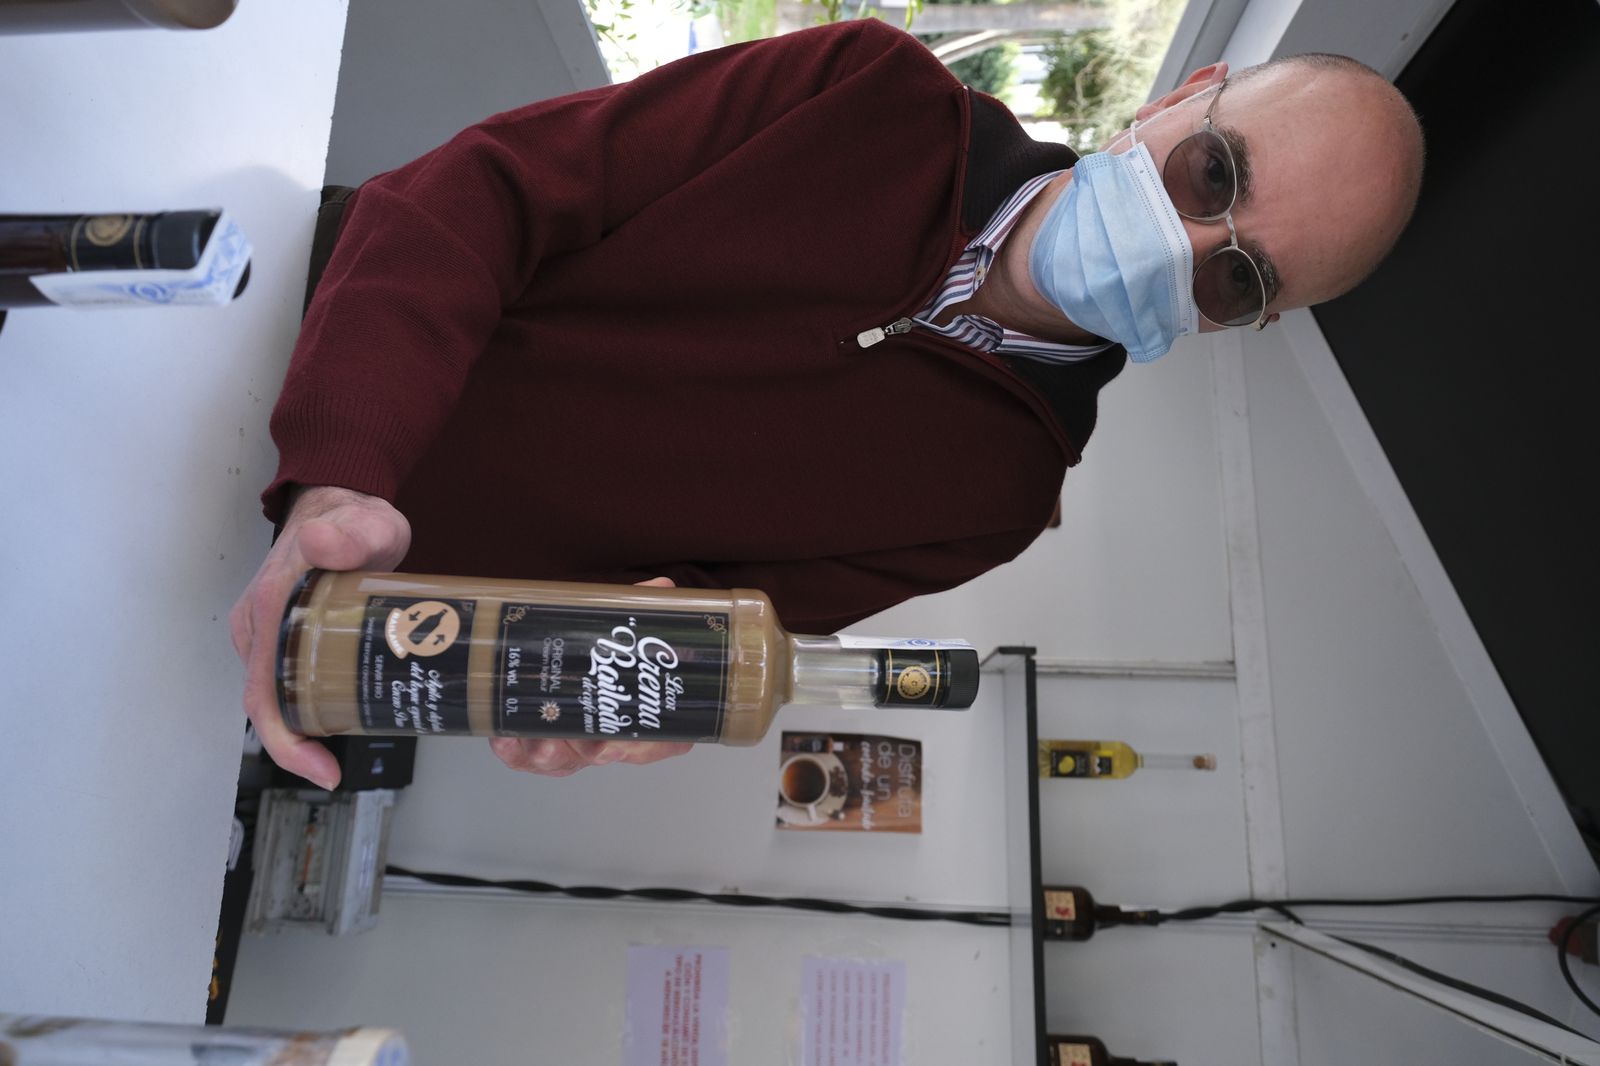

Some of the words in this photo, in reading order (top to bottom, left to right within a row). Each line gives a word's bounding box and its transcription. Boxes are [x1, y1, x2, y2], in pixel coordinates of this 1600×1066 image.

[507, 647, 521, 667] 16%
[542, 637, 552, 664] Cream
[375, 655, 383, 681] SERVIR
[410, 662, 424, 680] del
[549, 638, 564, 693] ORIGINAL
[540, 666, 550, 692] liqueur
[582, 677, 597, 691] de
[637, 636, 679, 729] Crema
[664, 672, 685, 712] Licor
[425, 700, 438, 711] y
[578, 692, 598, 714] café
[878, 742, 894, 768] de
[878, 775, 892, 800] un
[898, 744, 916, 817] Disfruta
